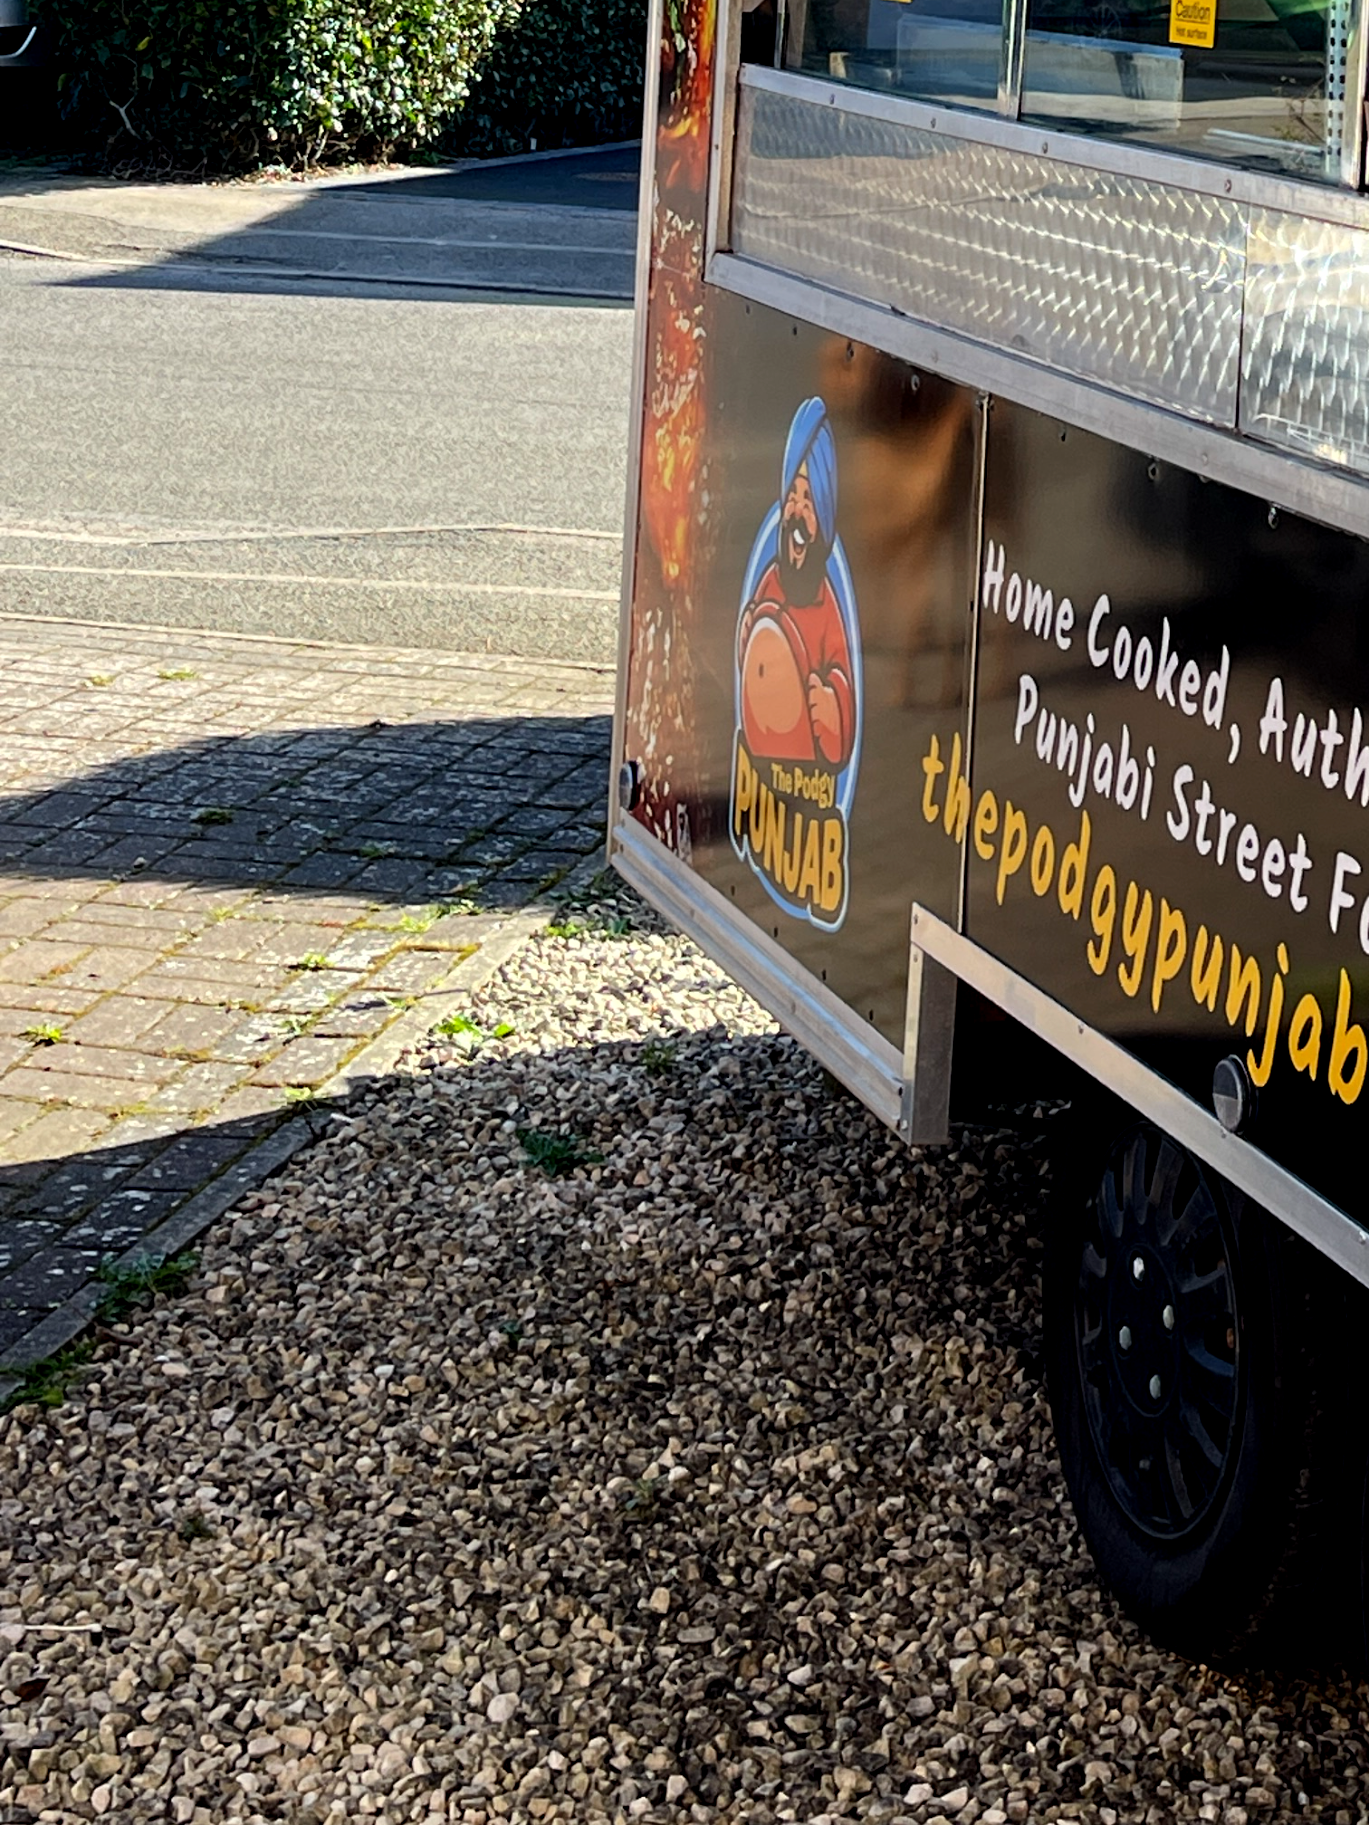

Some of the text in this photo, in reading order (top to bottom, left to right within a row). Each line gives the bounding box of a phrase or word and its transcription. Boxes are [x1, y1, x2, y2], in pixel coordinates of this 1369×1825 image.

[1175, 0, 1211, 21] Caution
[983, 539, 1074, 651] Home
[1087, 594, 1241, 764] Cooked,
[735, 743, 843, 912] PUNJAB
[771, 762, 835, 809] The Podgy
[1014, 674, 1156, 820] Punjabi
[1166, 764, 1314, 913] Street
